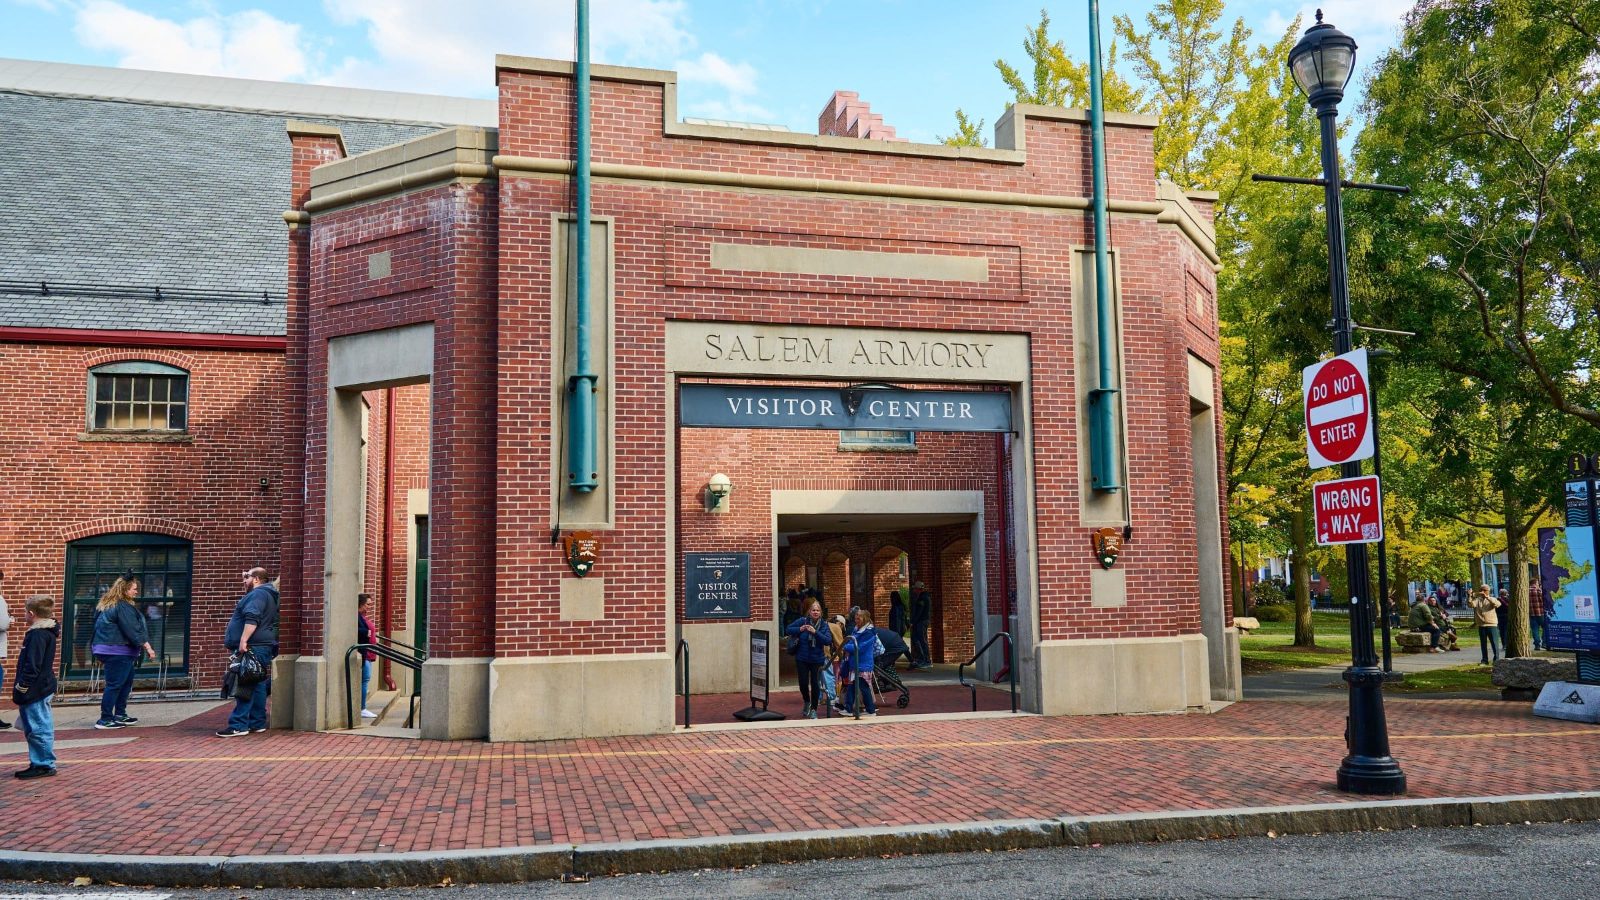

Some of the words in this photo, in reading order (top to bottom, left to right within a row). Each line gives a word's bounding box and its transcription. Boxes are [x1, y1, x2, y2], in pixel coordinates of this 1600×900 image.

[705, 334, 833, 364] SALEM
[849, 339, 993, 368] ARMORY
[1313, 383, 1328, 402] DO
[1334, 374, 1356, 395] NOT
[727, 397, 835, 416] VISITOR
[869, 400, 974, 418] CENTER
[1320, 422, 1357, 445] ENTER
[1321, 487, 1371, 511] WRONG
[1331, 513, 1361, 535] WAY
[698, 583, 738, 591] VISITOR
[698, 592, 738, 600] CENTER
